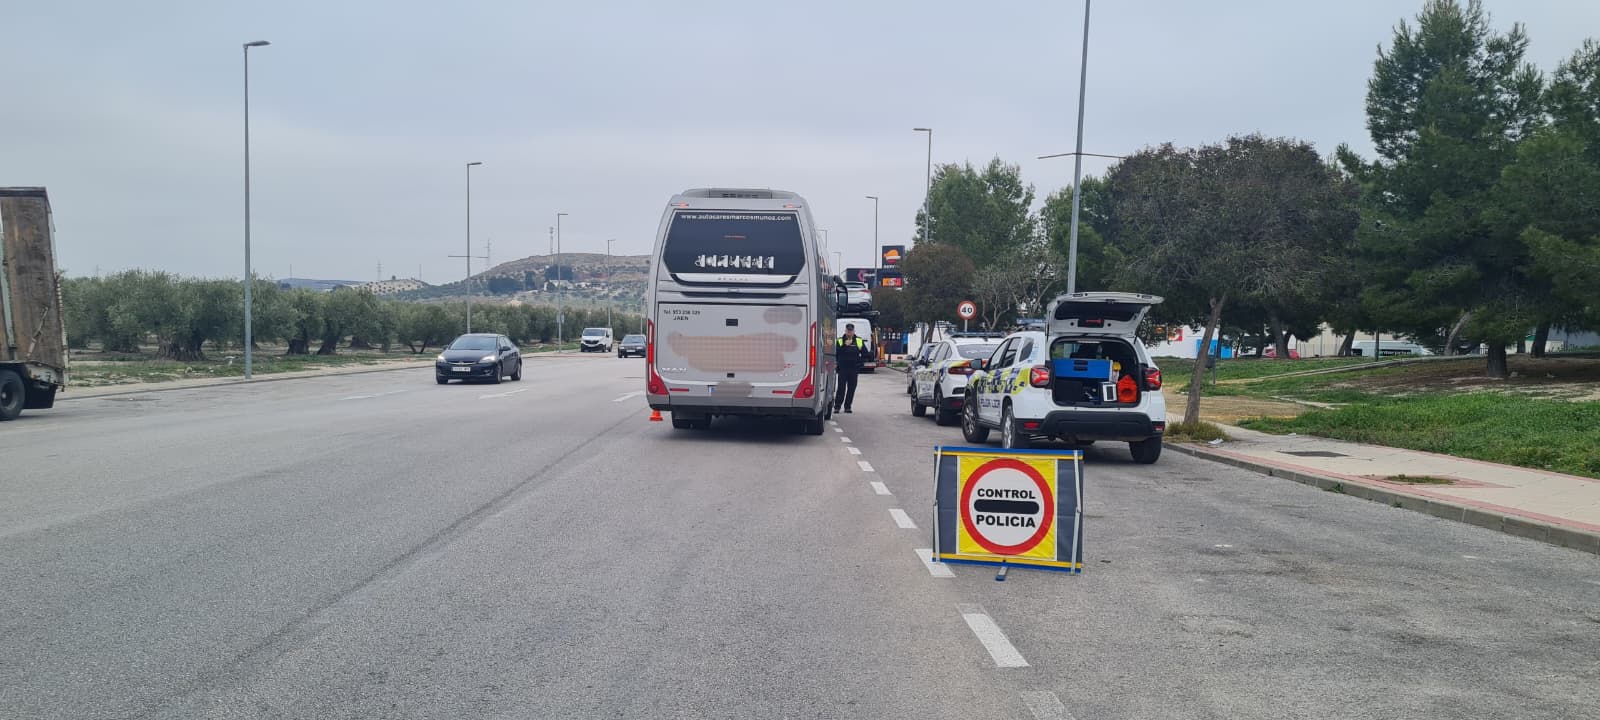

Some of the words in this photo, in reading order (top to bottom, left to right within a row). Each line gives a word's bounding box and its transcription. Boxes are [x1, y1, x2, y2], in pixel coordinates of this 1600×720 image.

[961, 306, 973, 314] 40
[977, 488, 1036, 500] CONTROL
[976, 515, 1036, 528] POLICIA
